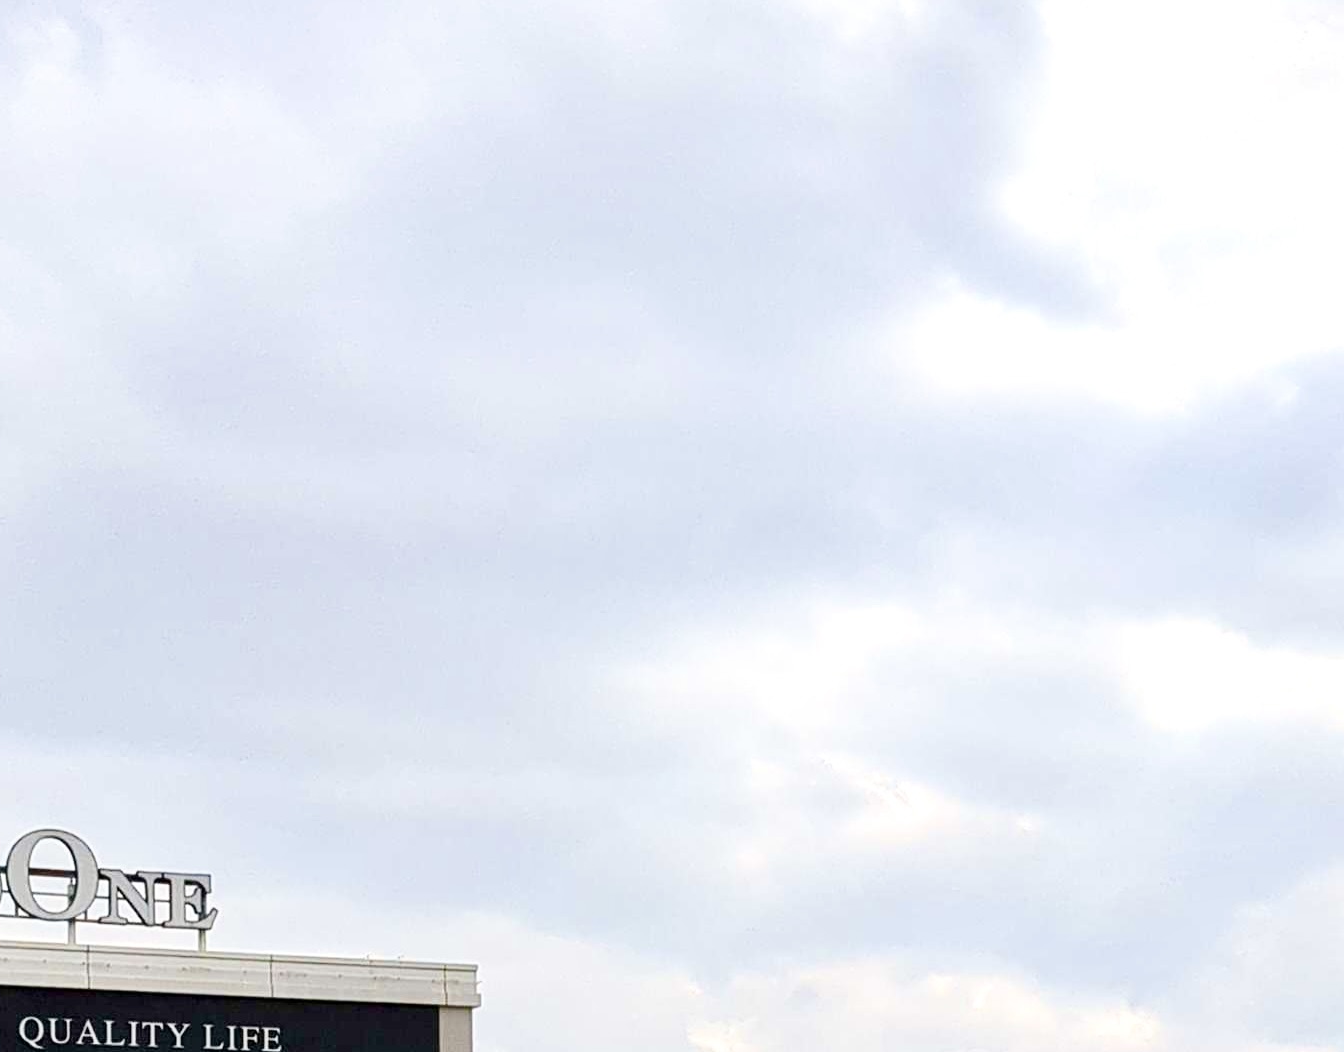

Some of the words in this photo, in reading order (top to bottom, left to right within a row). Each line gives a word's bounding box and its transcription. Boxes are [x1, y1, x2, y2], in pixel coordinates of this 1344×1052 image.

[7, 828, 219, 931] ONE
[18, 1016, 191, 1049] QUALITY
[202, 1023, 283, 1052] LIFE
